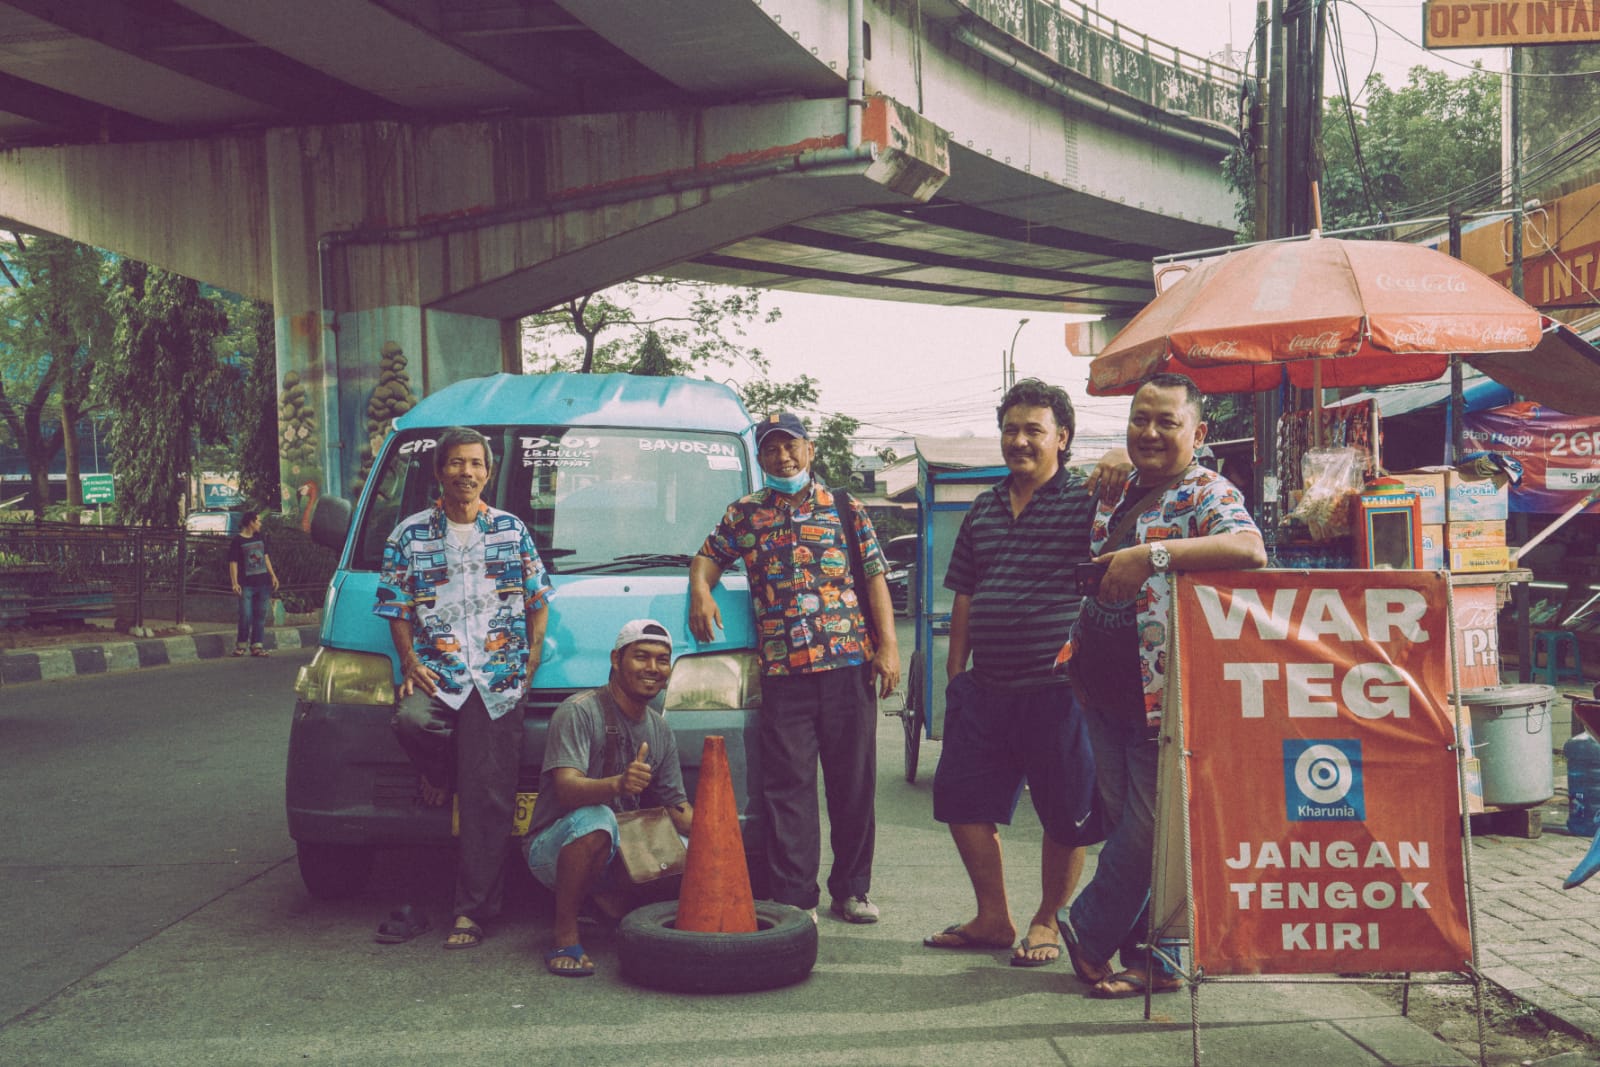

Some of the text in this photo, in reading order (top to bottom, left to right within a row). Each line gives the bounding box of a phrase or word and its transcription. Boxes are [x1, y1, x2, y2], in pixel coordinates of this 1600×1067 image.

[1430, 3, 1519, 38] OPTIK
[639, 439, 735, 457] BAYORAN
[1491, 433, 1534, 448] Happy
[1193, 584, 1431, 644] WAR
[1223, 662, 1412, 720] TEG
[1297, 805, 1355, 817] Kharunia
[1225, 841, 1431, 870] JANGAN
[1229, 881, 1432, 910] TENGOK
[1281, 922, 1380, 951] KIRI
